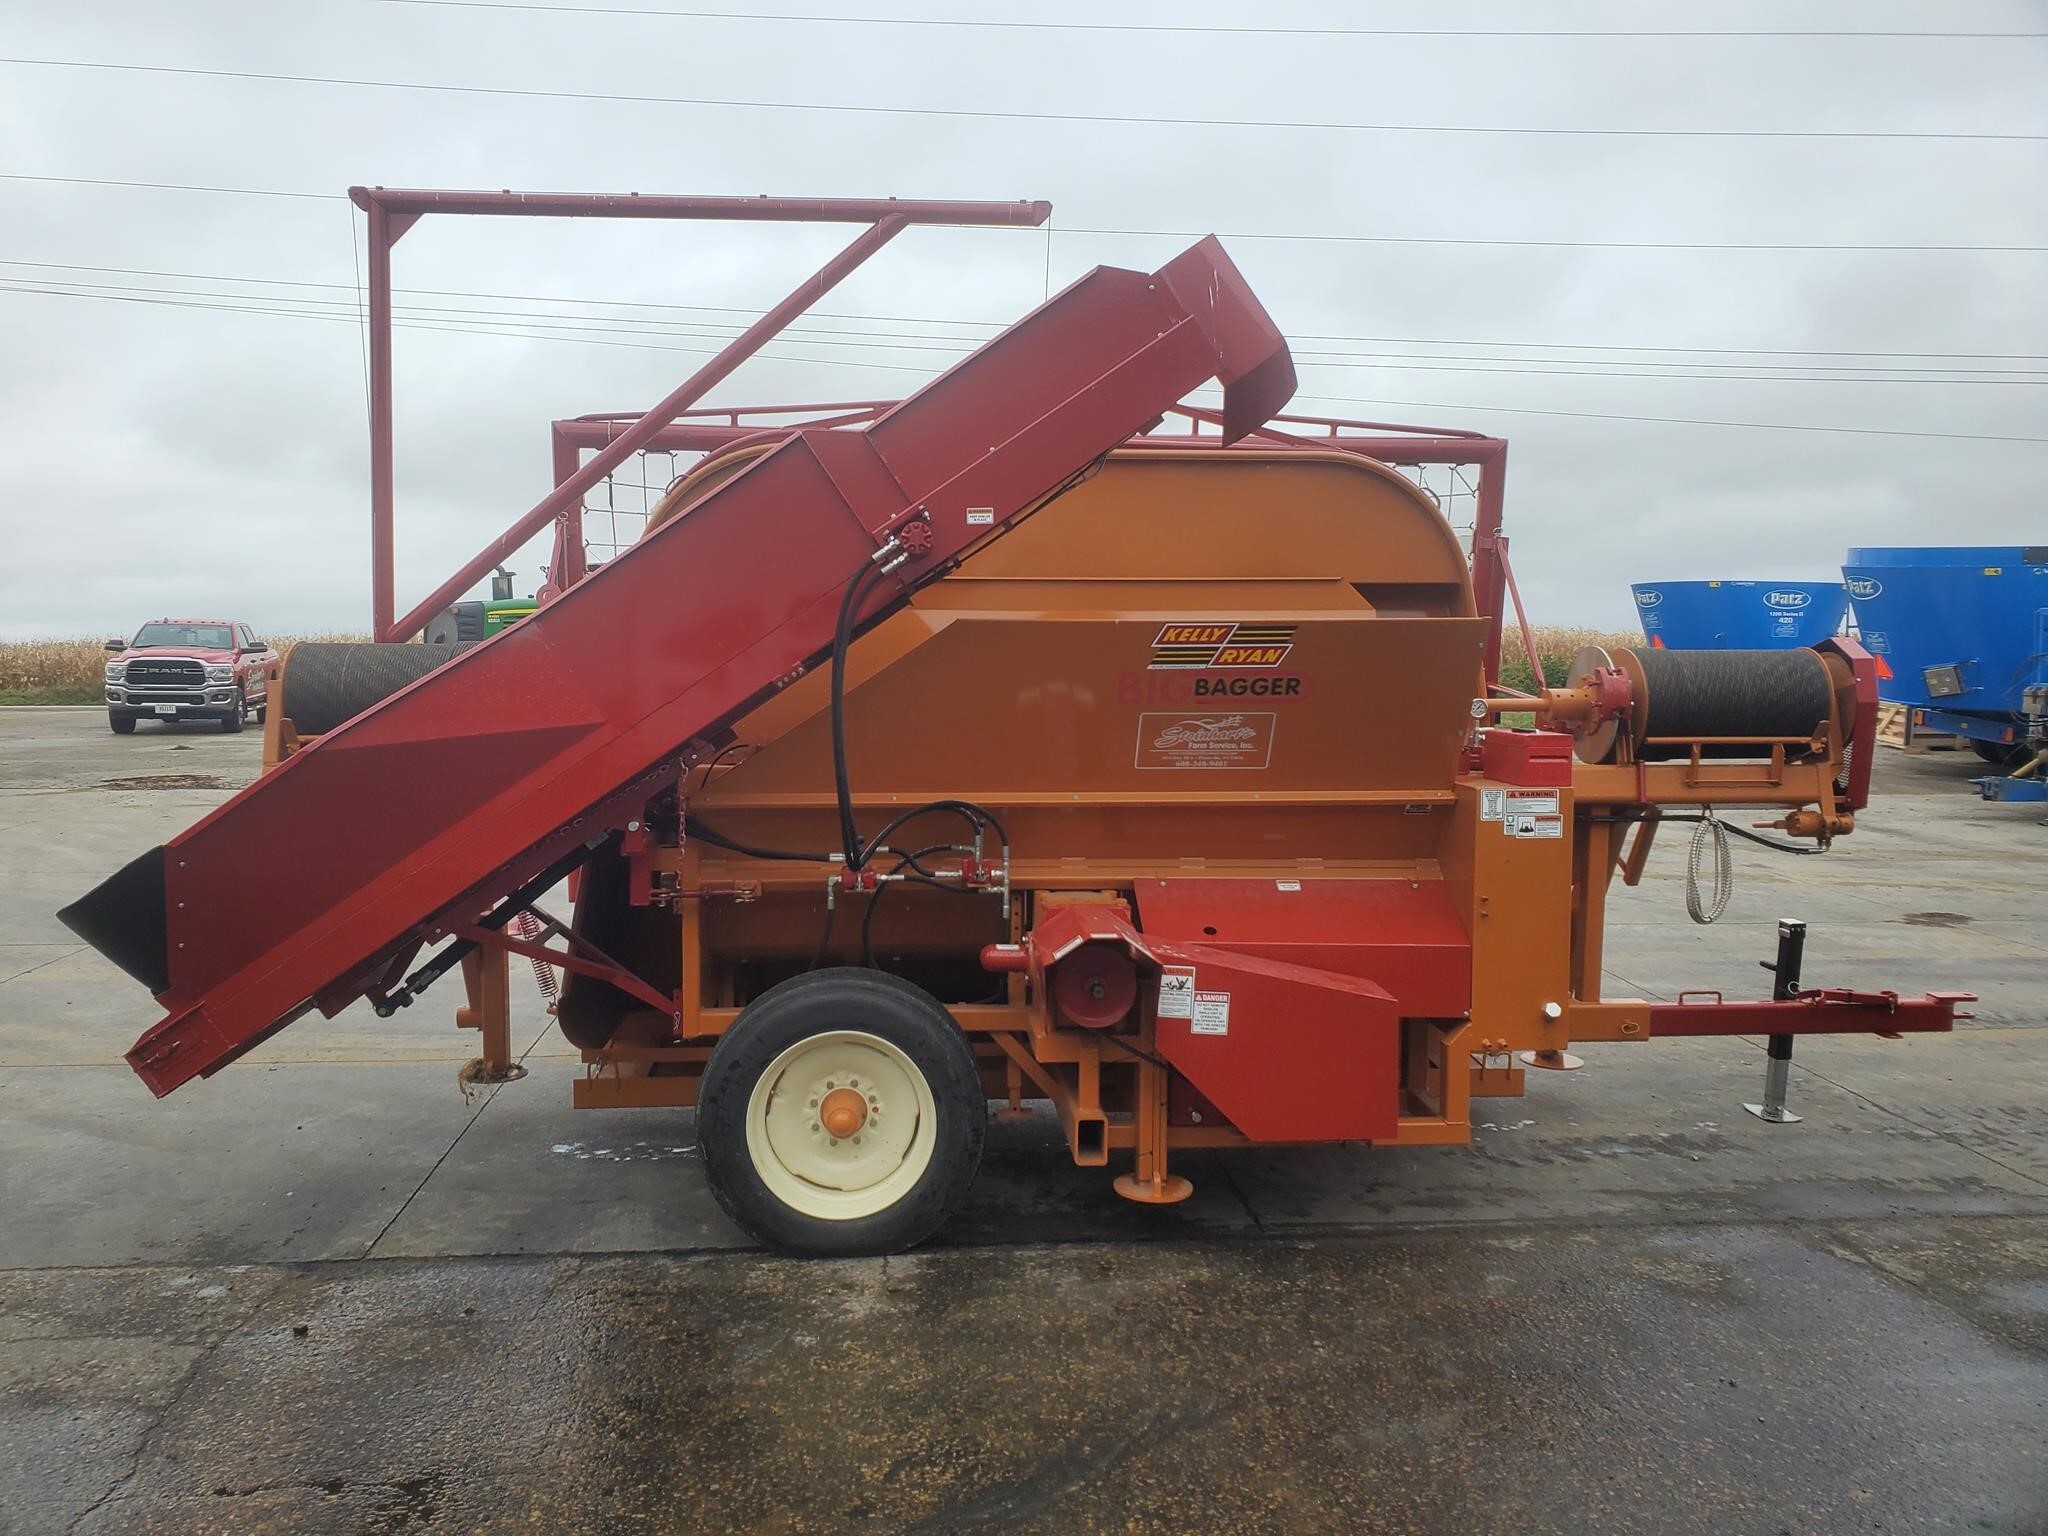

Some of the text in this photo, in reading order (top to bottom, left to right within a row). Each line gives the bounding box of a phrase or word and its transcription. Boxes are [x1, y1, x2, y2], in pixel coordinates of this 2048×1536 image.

[1771, 593, 1805, 604] Patz
[1162, 628, 1227, 642] KELLY
[1218, 649, 1283, 663] RYAN
[1194, 678, 1301, 696] BAGGER
[1202, 994, 1228, 1002] DANGER
